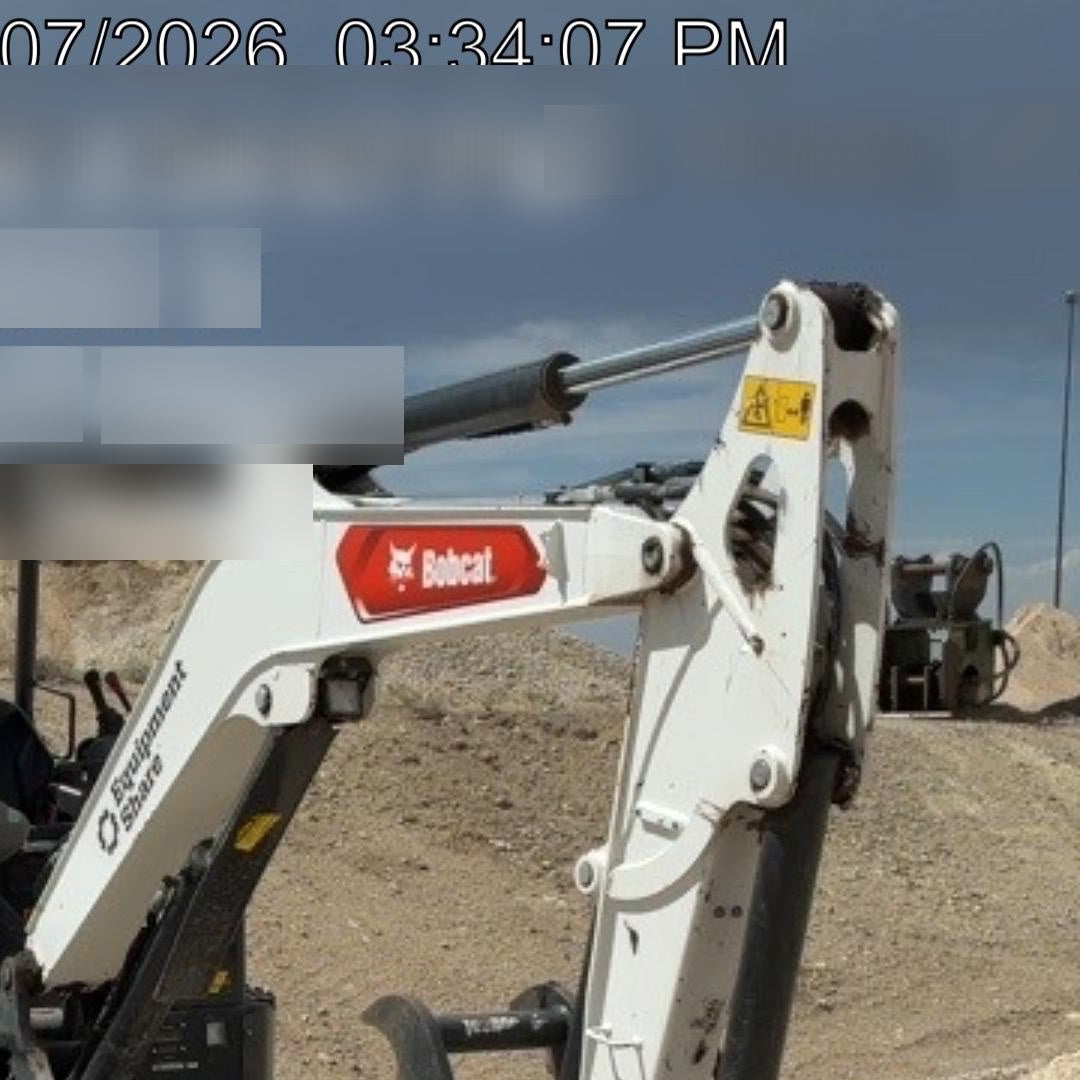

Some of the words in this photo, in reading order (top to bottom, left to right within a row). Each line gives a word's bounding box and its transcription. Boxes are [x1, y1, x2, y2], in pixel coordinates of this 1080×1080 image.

[423, 545, 495, 588] Bobcat
[111, 660, 187, 807] Equipment
[120, 754, 163, 832] Share
